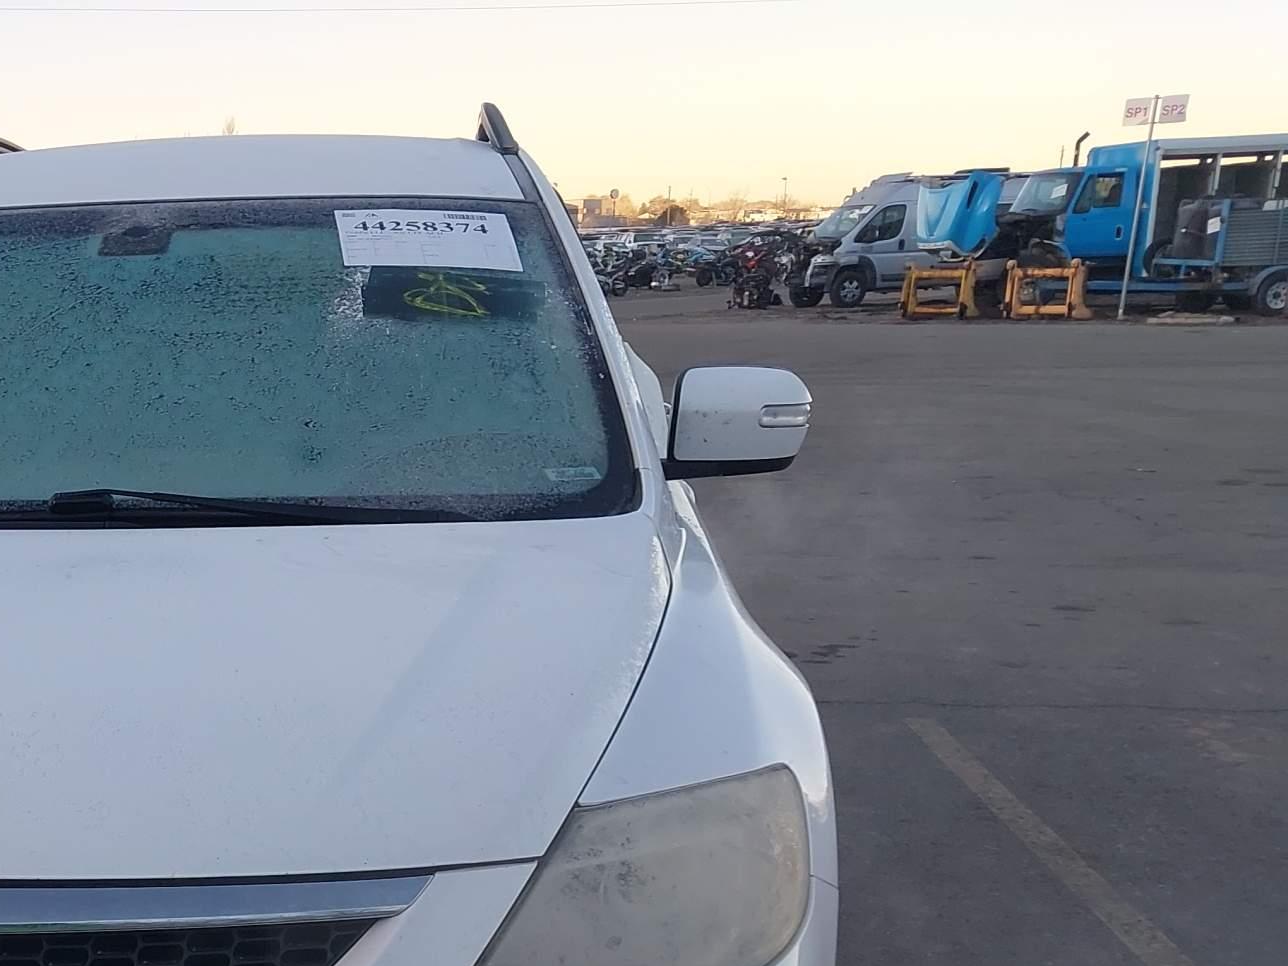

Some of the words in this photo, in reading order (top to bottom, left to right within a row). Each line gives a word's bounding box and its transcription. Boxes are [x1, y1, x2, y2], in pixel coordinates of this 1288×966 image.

[1125, 106, 1148, 119] SP1
[1161, 103, 1186, 117] SP2
[353, 220, 489, 235] 44258374
